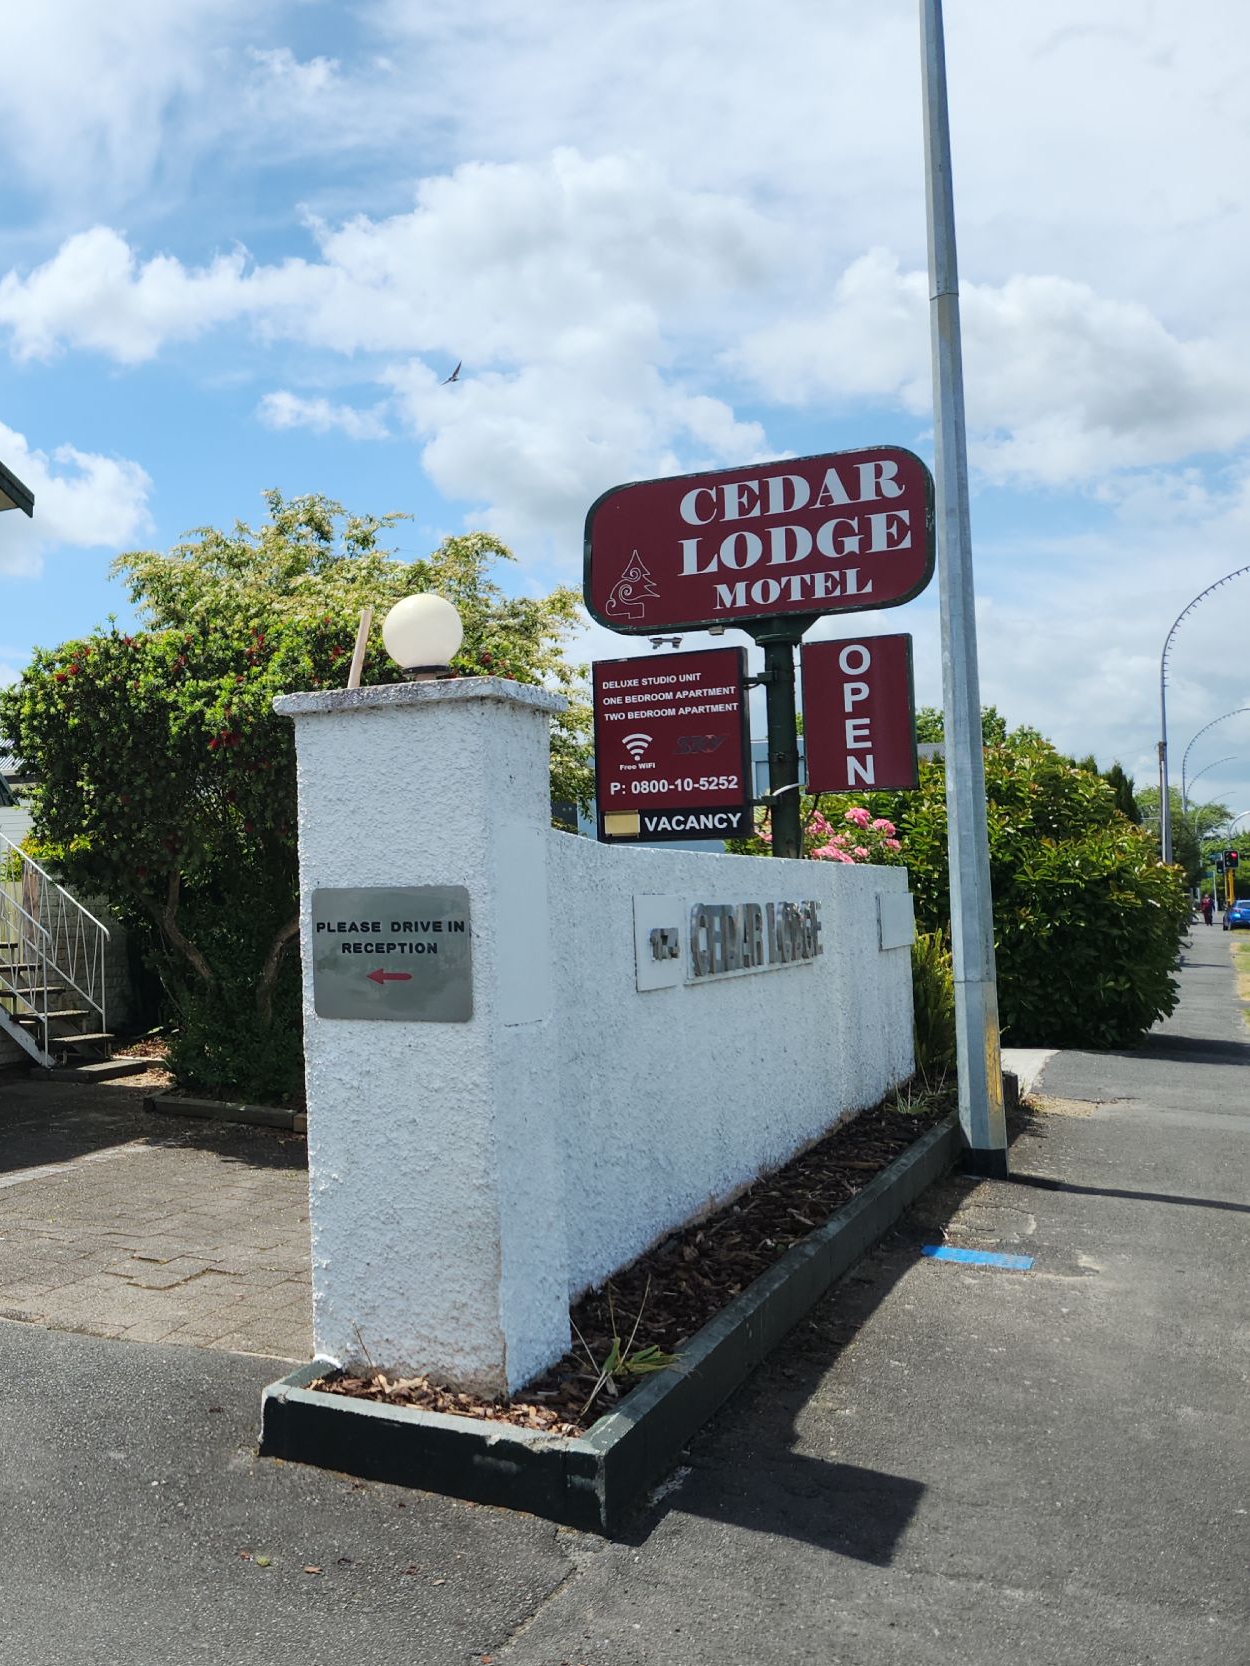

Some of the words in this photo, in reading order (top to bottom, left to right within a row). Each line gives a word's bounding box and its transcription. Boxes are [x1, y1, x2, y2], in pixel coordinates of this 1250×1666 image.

[679, 459, 906, 526] CEDAR
[677, 509, 912, 576] LODGE
[712, 567, 873, 610] MOTEL
[602, 678, 639, 690] DELUXE
[641, 674, 677, 686] STUDIO
[679, 672, 702, 683] UNIT
[602, 696, 623, 706] ONE
[625, 691, 673, 704] BEDROOM
[675, 686, 736, 699] APARTMENT
[604, 712, 626, 721] TWO
[627, 708, 676, 720] BEDROOM
[678, 702, 739, 716] APARTMENT
[838, 644, 875, 786] OPEN
[619, 763, 637, 771] Free
[610, 781, 626, 795] P:
[631, 775, 738, 794] 0800-10-5252
[644, 812, 742, 831] VACANCY
[316, 921, 381, 933] PLEASE
[390, 921, 443, 933] DRIVE
[448, 920, 465, 933] IN
[341, 942, 438, 954] RECEPTION
